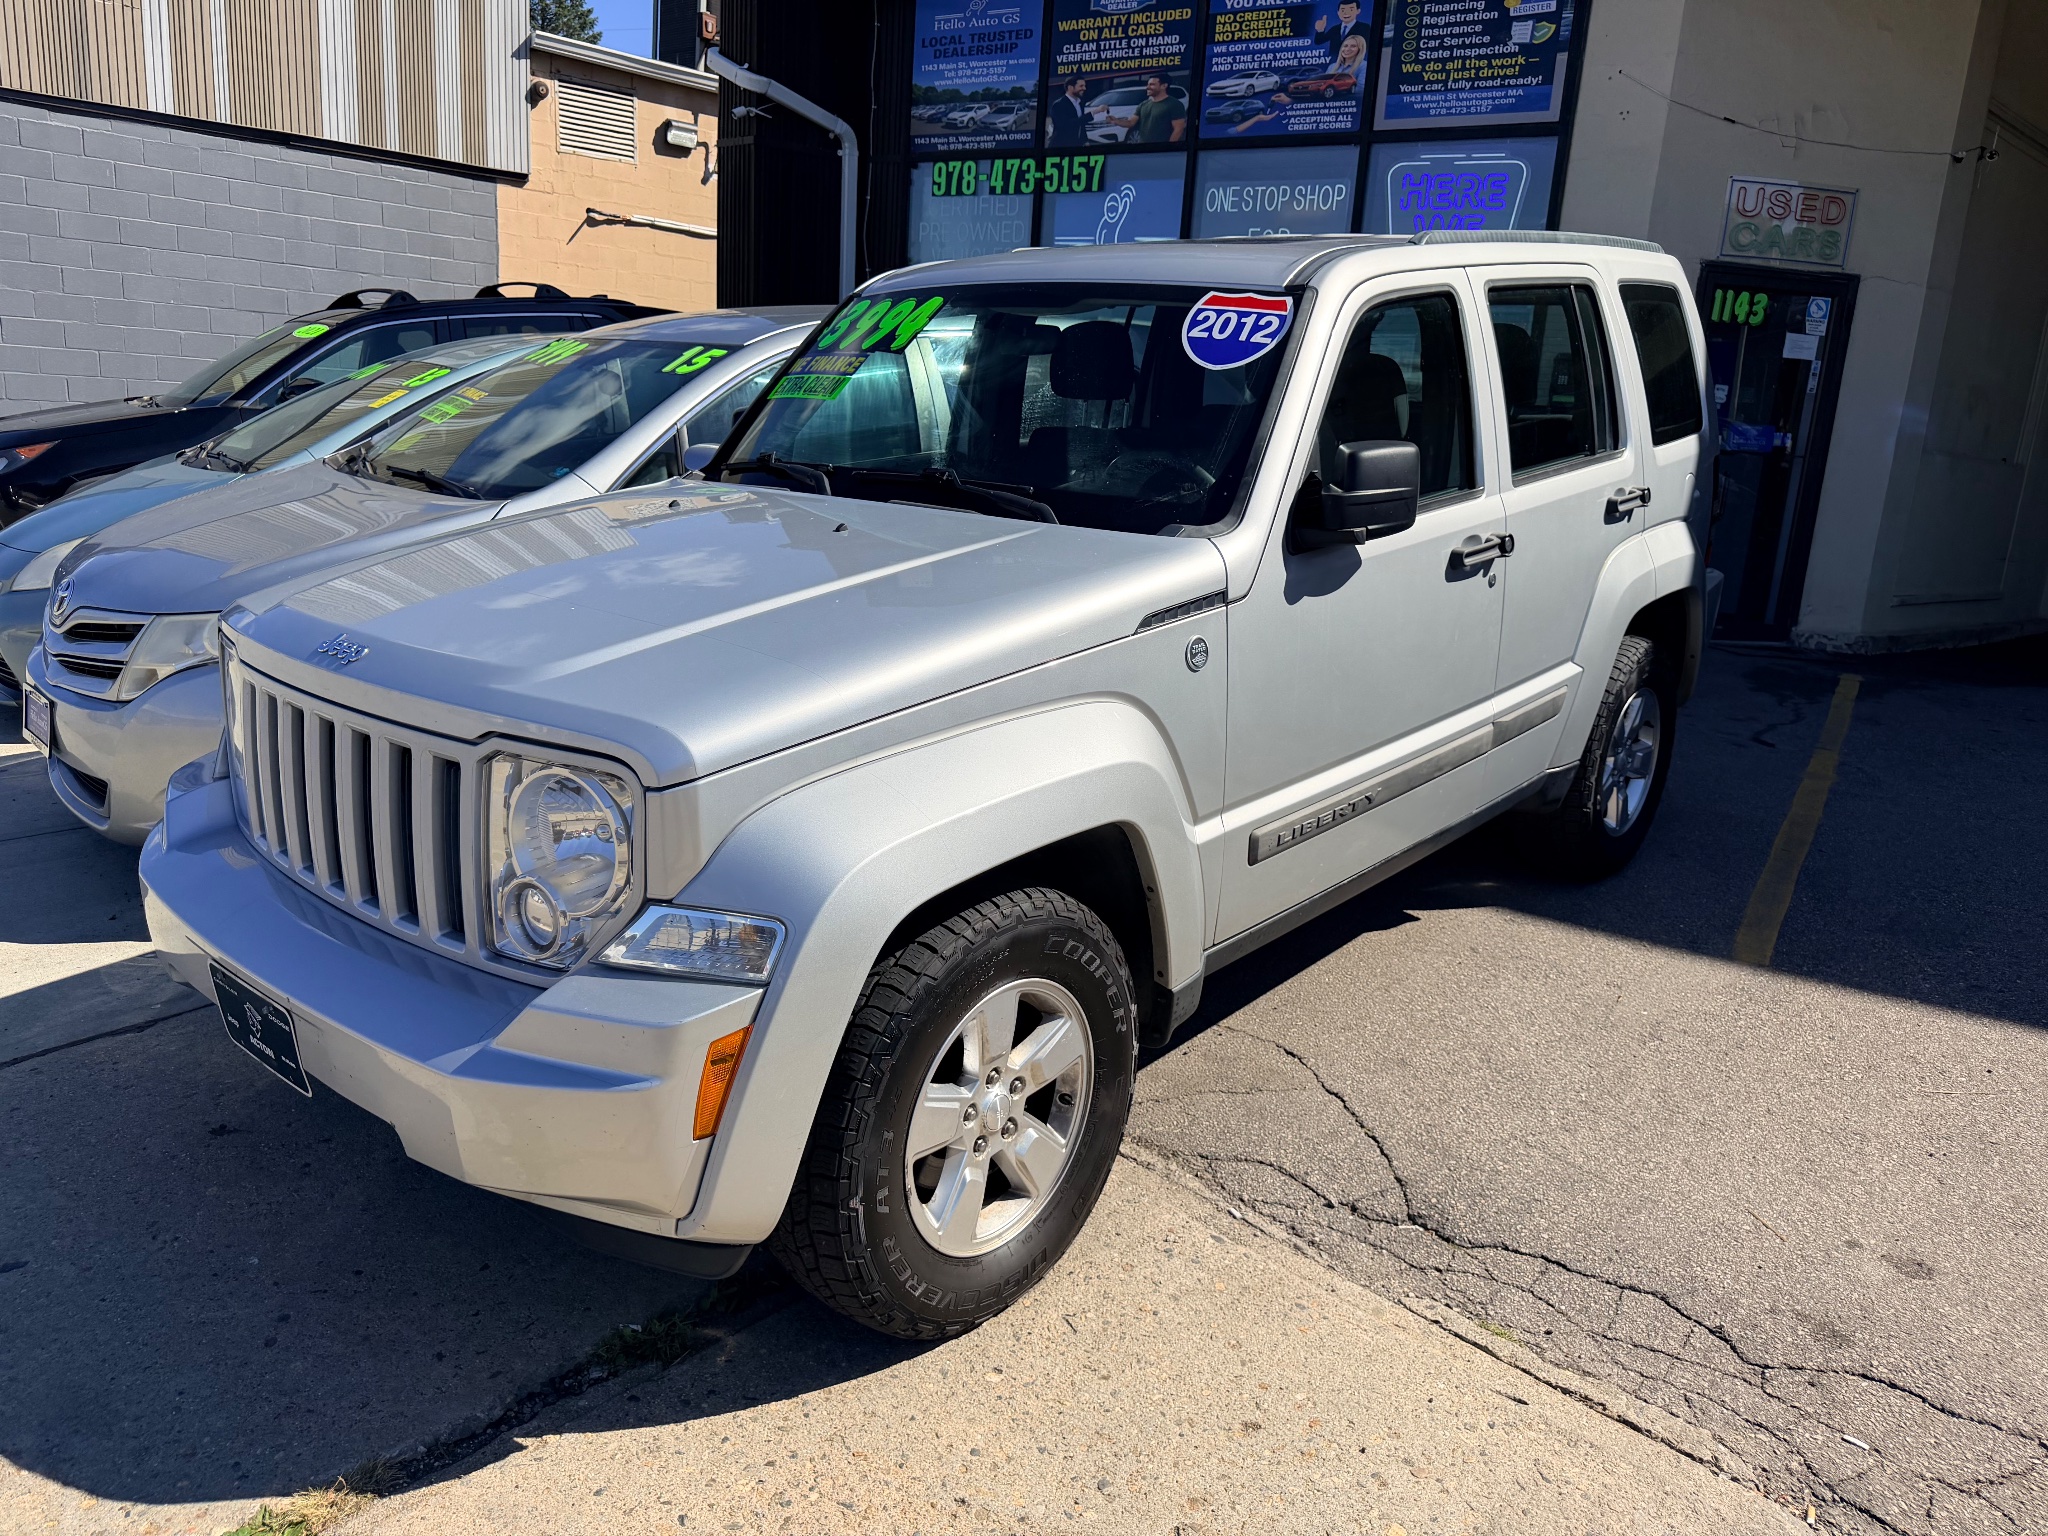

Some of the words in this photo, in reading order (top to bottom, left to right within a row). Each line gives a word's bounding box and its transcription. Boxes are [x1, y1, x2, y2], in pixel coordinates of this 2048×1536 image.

[1107, 2, 1138, 11] DEALER
[1424, 0, 1486, 14] Financing
[1513, 2, 1552, 14] REGISTER
[934, 18, 966, 31] Hello
[969, 17, 998, 28] Auto
[1002, 13, 1020, 24] GS
[1058, 14, 1128, 32] WARRANTY
[1130, 8, 1192, 24] INCLUDED
[1216, 14, 1234, 24] NO
[1236, 9, 1286, 22] CREDIT?
[1422, 10, 1499, 26] Registration
[1080, 29, 1098, 41] ON
[1101, 27, 1125, 39] ALL
[1128, 23, 1164, 37] CARS
[1215, 23, 1240, 33] BAD
[1242, 18, 1292, 31] CREDIT?
[1421, 23, 1483, 37] Insurance
[921, 34, 966, 49] LOCAL
[969, 28, 1034, 44] TRUSTED
[1214, 33, 1233, 43] NO
[1234, 27, 1294, 41] PROBLEM.
[1420, 38, 1441, 49] Car
[1443, 34, 1491, 47] Service
[933, 42, 1019, 60] DEALERSHIP
[1063, 42, 1097, 54] CLEAN
[1099, 39, 1128, 50] TITLE
[1130, 38, 1146, 47] ON
[1148, 34, 1180, 46] HAND
[1213, 45, 1228, 54] WE
[1229, 44, 1247, 52] GOT
[1248, 42, 1267, 51] YOU
[1269, 38, 1312, 49] COVERED
[1418, 50, 1450, 60] State
[1453, 44, 1519, 58] Inspection
[1056, 51, 1098, 63] VERIFIED
[1100, 48, 1141, 59] VEHICLE
[1142, 44, 1187, 56] HISTORY
[1212, 56, 1234, 65] PICK
[1235, 54, 1253, 63] THE
[1254, 53, 1274, 62] CAR
[1275, 51, 1295, 60] YOU
[1296, 49, 1326, 58] WANT
[921, 64, 937, 72] 1143
[939, 62, 957, 70] Main
[969, 59, 1008, 68] Worcester
[1057, 64, 1079, 75] BUY
[1081, 61, 1110, 72] WITH
[1112, 56, 1182, 70] CONFIDENCE
[1211, 64, 1231, 72] AND
[1232, 62, 1260, 71] DRIVE
[1261, 60, 1270, 68] IT
[1271, 59, 1299, 68] HOME
[1300, 56, 1332, 66] TODAY
[1402, 63, 1422, 73] We
[1425, 60, 1442, 71] do
[1445, 58, 1462, 70] all
[1465, 57, 1488, 68] the
[1491, 54, 1526, 67] work
[934, 74, 1017, 86] www.HelloAutoGS.com
[944, 70, 956, 78] Tel:
[957, 66, 1007, 77] 978-473-5157
[1422, 71, 1446, 81] You
[1449, 69, 1476, 80] just
[1478, 66, 1519, 78] drive!
[1399, 84, 1424, 93] Your
[1425, 82, 1445, 91] car,
[1447, 79, 1472, 90] fully
[1474, 75, 1543, 88] road-ready!
[1403, 95, 1421, 103] 1143
[1422, 93, 1445, 102] Main
[1458, 90, 1506, 99] Worcester
[1507, 89, 1524, 97] MA
[1413, 97, 1516, 109] www.helloautogs.com
[1292, 102, 1325, 110] CERTIFIED
[1325, 100, 1356, 108] VEHICLES
[1429, 105, 1493, 116] 978-473-5157
[1288, 123, 1317, 131] CREDIT
[1318, 121, 1352, 130] SCORES
[1289, 115, 1336, 124] ACCEPTING
[915, 137, 930, 145] 1143
[930, 136, 948, 144] Main
[959, 134, 995, 143] Worcester
[995, 133, 1009, 141] MA
[1009, 132, 1032, 140] 01603
[937, 143, 950, 151] Tel:
[950, 141, 997, 151] 978-473-5157
[933, 155, 1105, 196] 978-473-5157
[1206, 186, 1241, 213] ONE
[1242, 185, 1291, 213] STOP
[1293, 184, 1347, 211] SHOP
[1400, 173, 1510, 211] HERE
[1737, 186, 1846, 225] USED
[1729, 222, 1841, 260] CARS
[1711, 288, 1769, 326] 1143
[1187, 310, 1280, 344] 2012
[662, 346, 728, 374] 15
[805, 355, 867, 374] FINANCE
[1276, 787, 1382, 847] LIBERTY
[1044, 934, 1127, 1033] COOPER
[882, 1233, 1048, 1311] DISCOVERER
